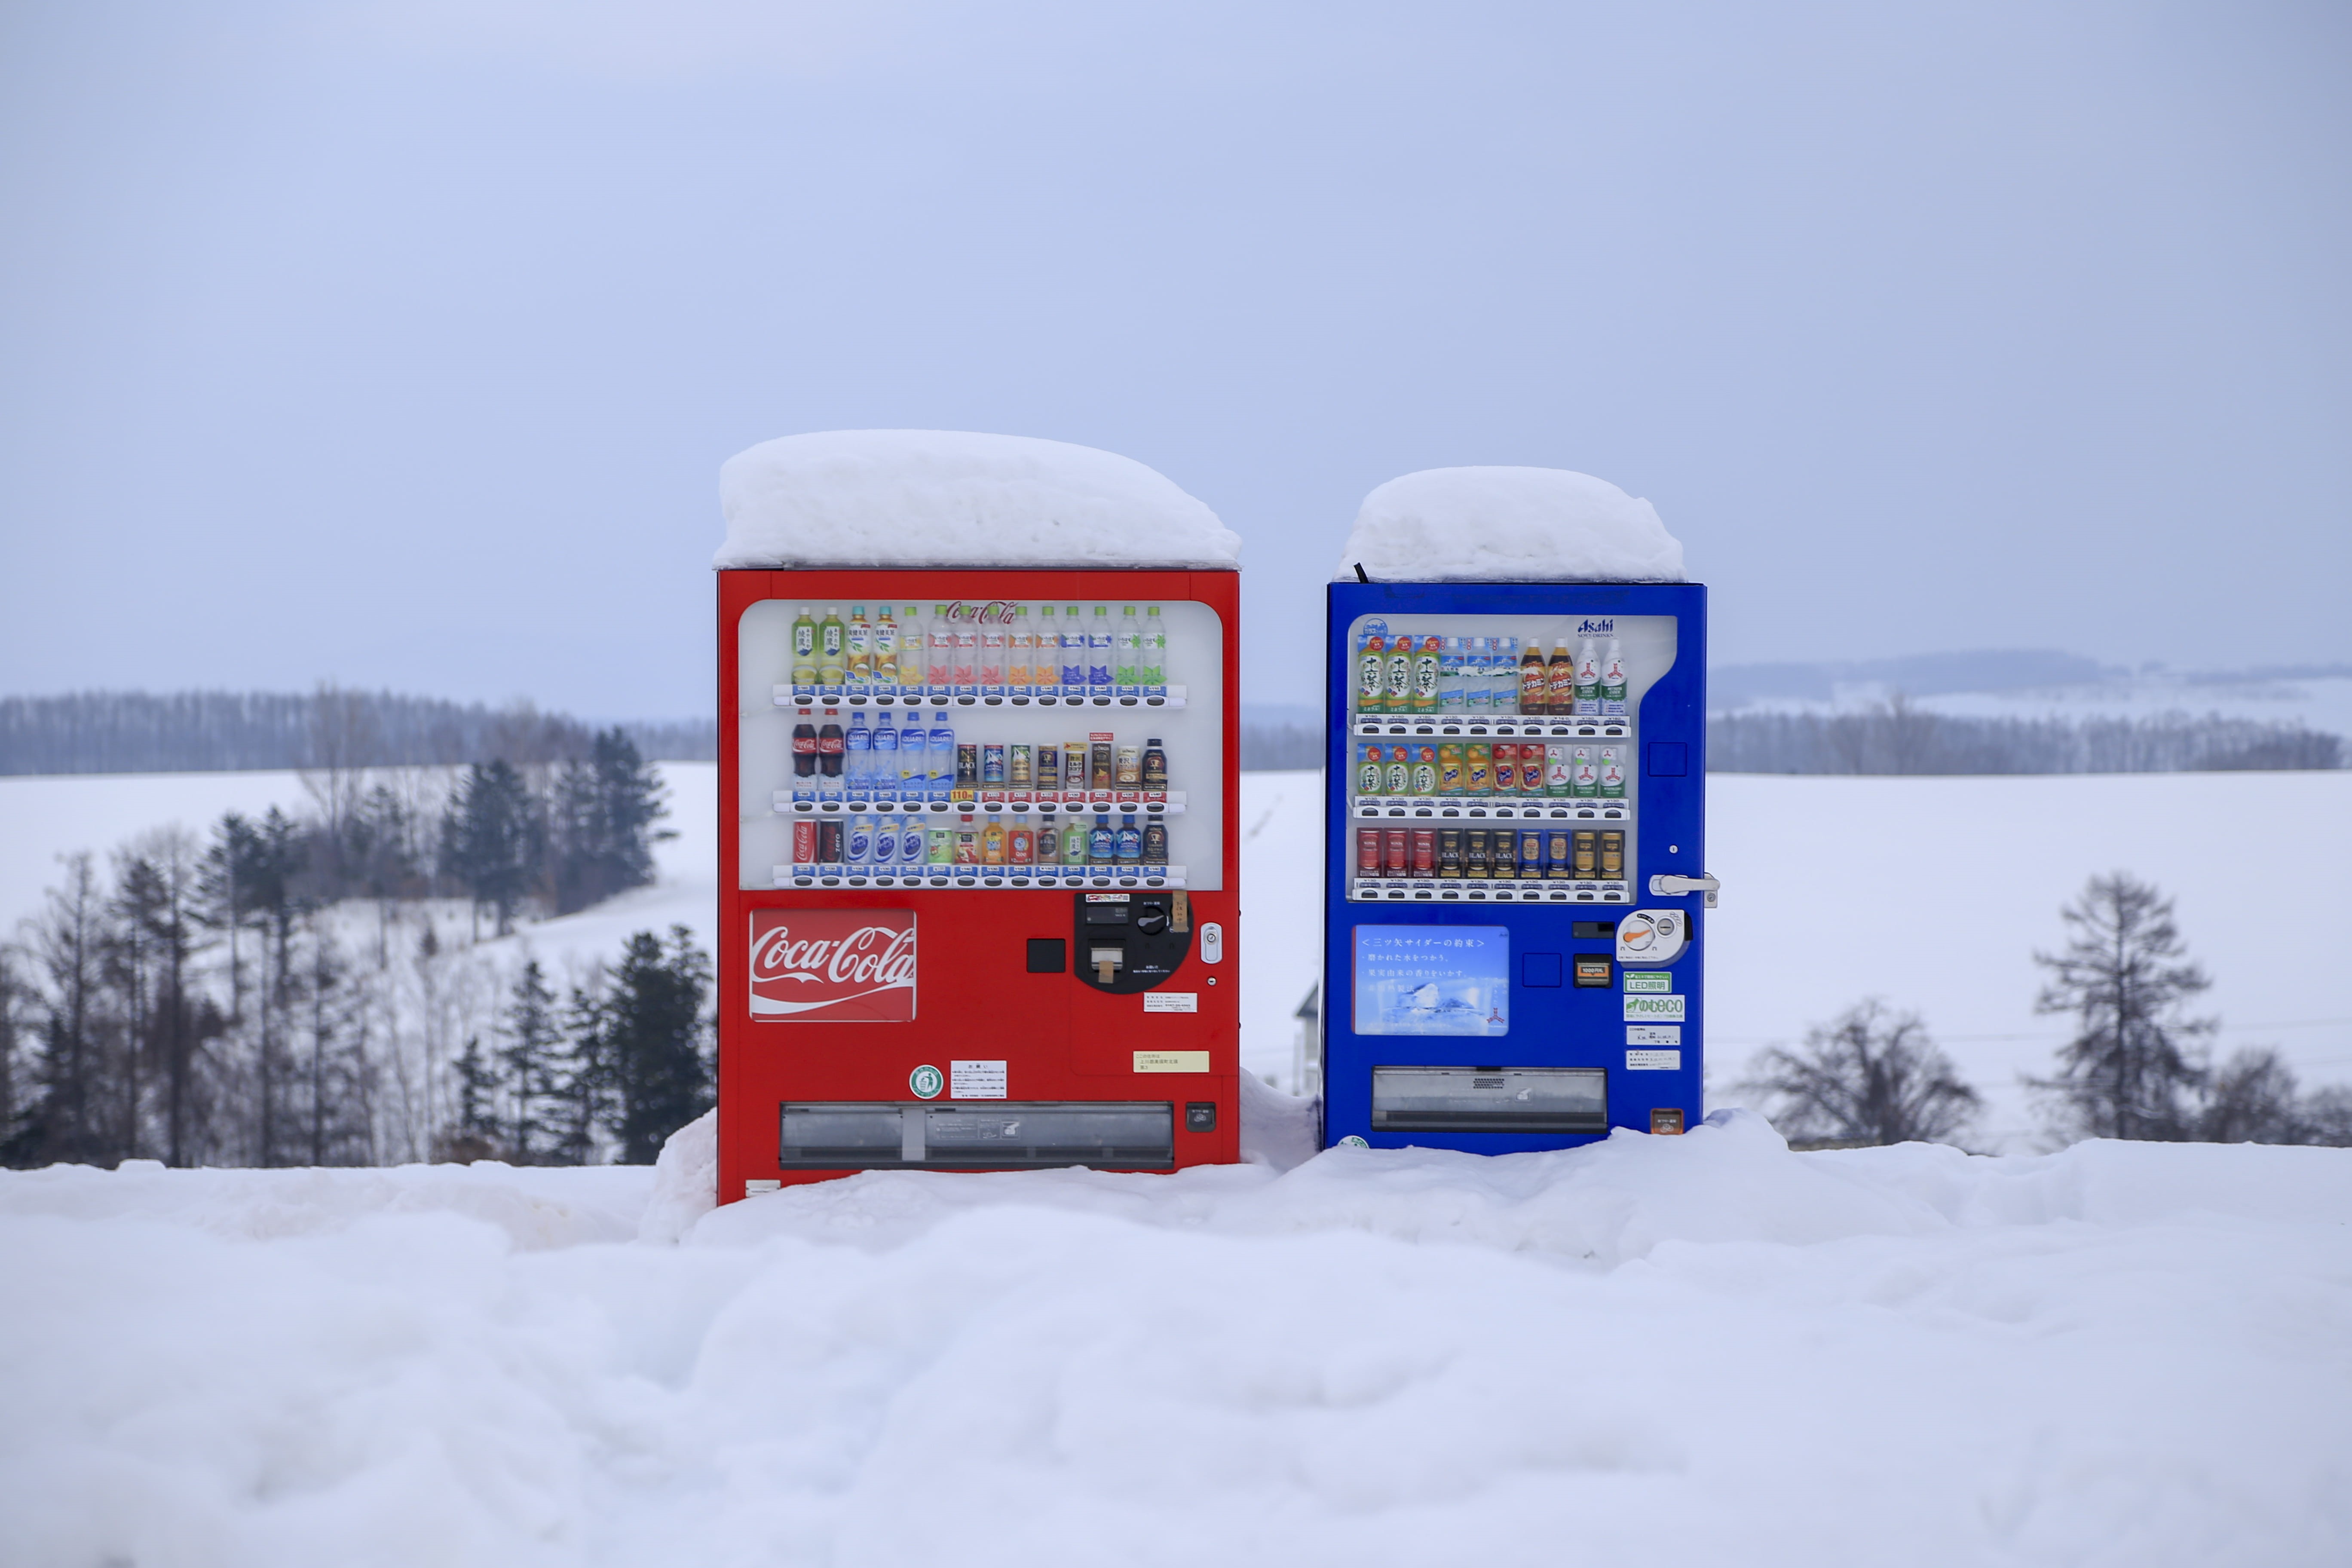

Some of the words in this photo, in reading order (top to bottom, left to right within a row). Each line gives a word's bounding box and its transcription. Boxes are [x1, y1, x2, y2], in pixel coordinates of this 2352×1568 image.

[1577, 619, 1613, 633] Asahi
[1366, 658, 1382, 691] 十六茶
[1393, 658, 1410, 692] 十六茶
[1420, 658, 1437, 692] 十六茶
[794, 739, 815, 749] Coca-Cola
[821, 739, 842, 749] Coca-Cola
[796, 825, 808, 860] Coca-Cola
[752, 926, 914, 983] Coca-Cola
[1629, 981, 1665, 990] LED照明
[1639, 999, 1683, 1013] のむeco
